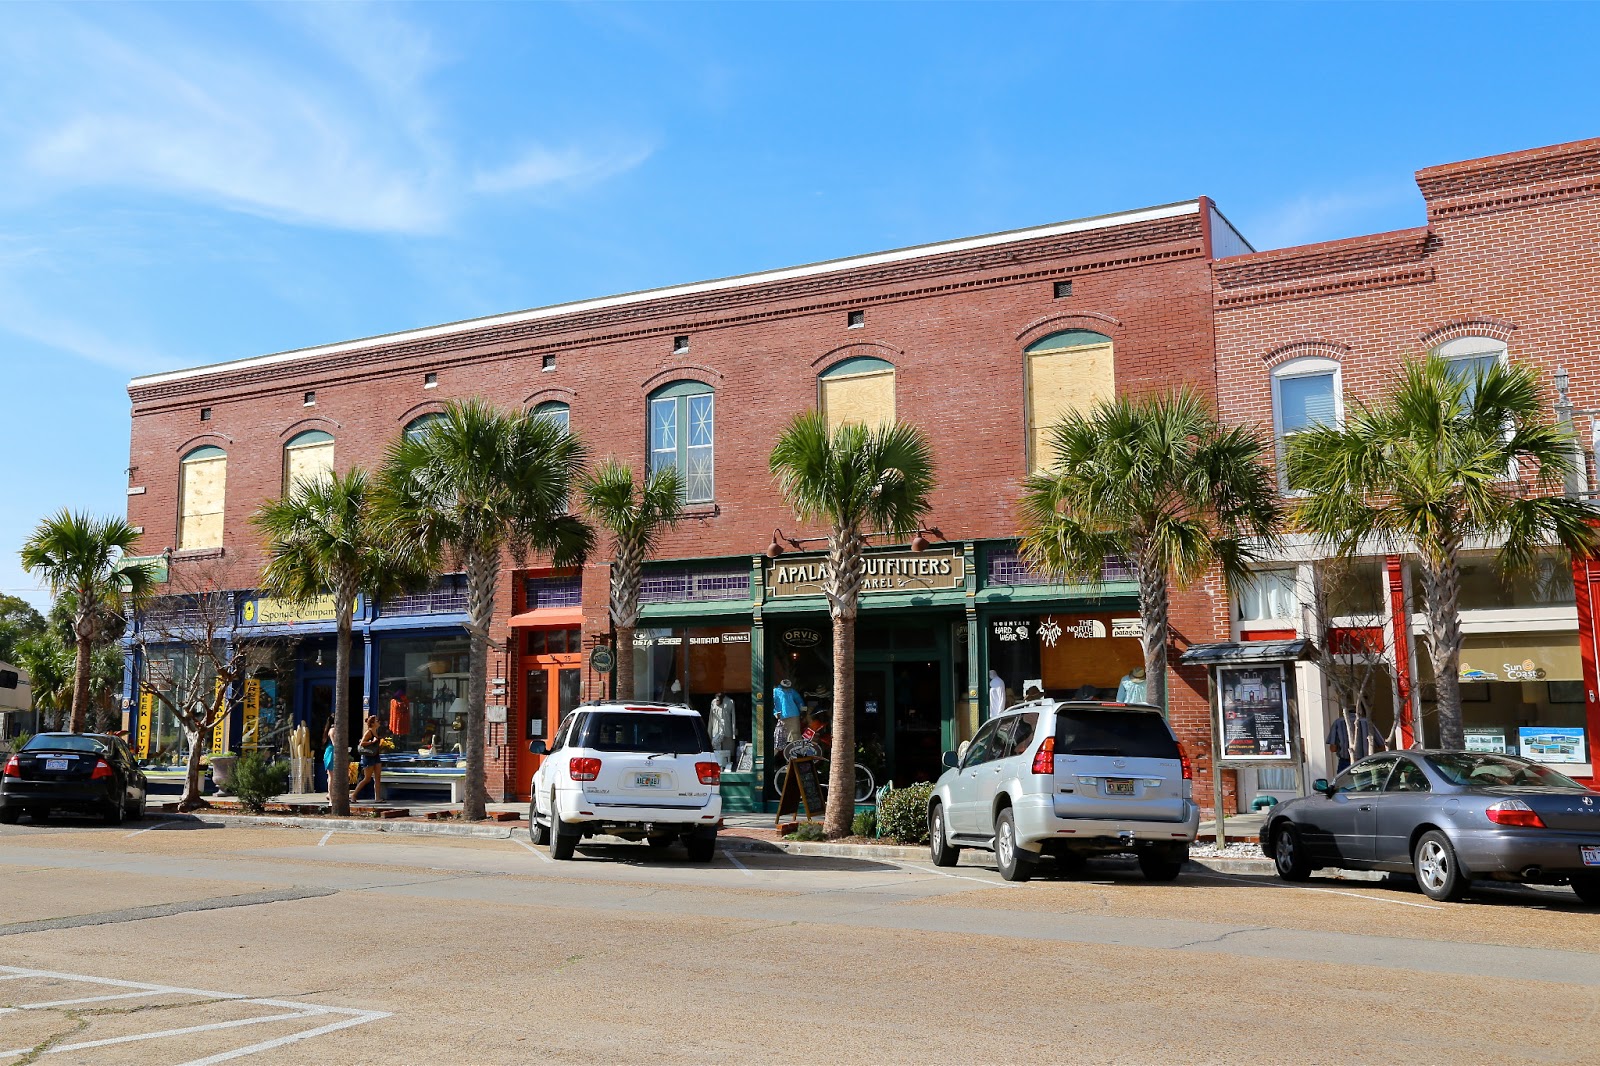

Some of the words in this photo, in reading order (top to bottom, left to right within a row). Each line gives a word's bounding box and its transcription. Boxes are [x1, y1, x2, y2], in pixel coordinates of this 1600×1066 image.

[861, 578, 893, 589] AREL
[294, 607, 337, 619] Compan
[994, 626, 1013, 634] HARD
[689, 636, 720, 645] SHIMANO
[723, 634, 748, 642] SIMMS
[785, 631, 819, 641] ORVIS
[999, 633, 1018, 642] WEAR
[1503, 663, 1522, 672] Sun
[1507, 670, 1537, 680] Coast
[140, 682, 149, 717] REEK
